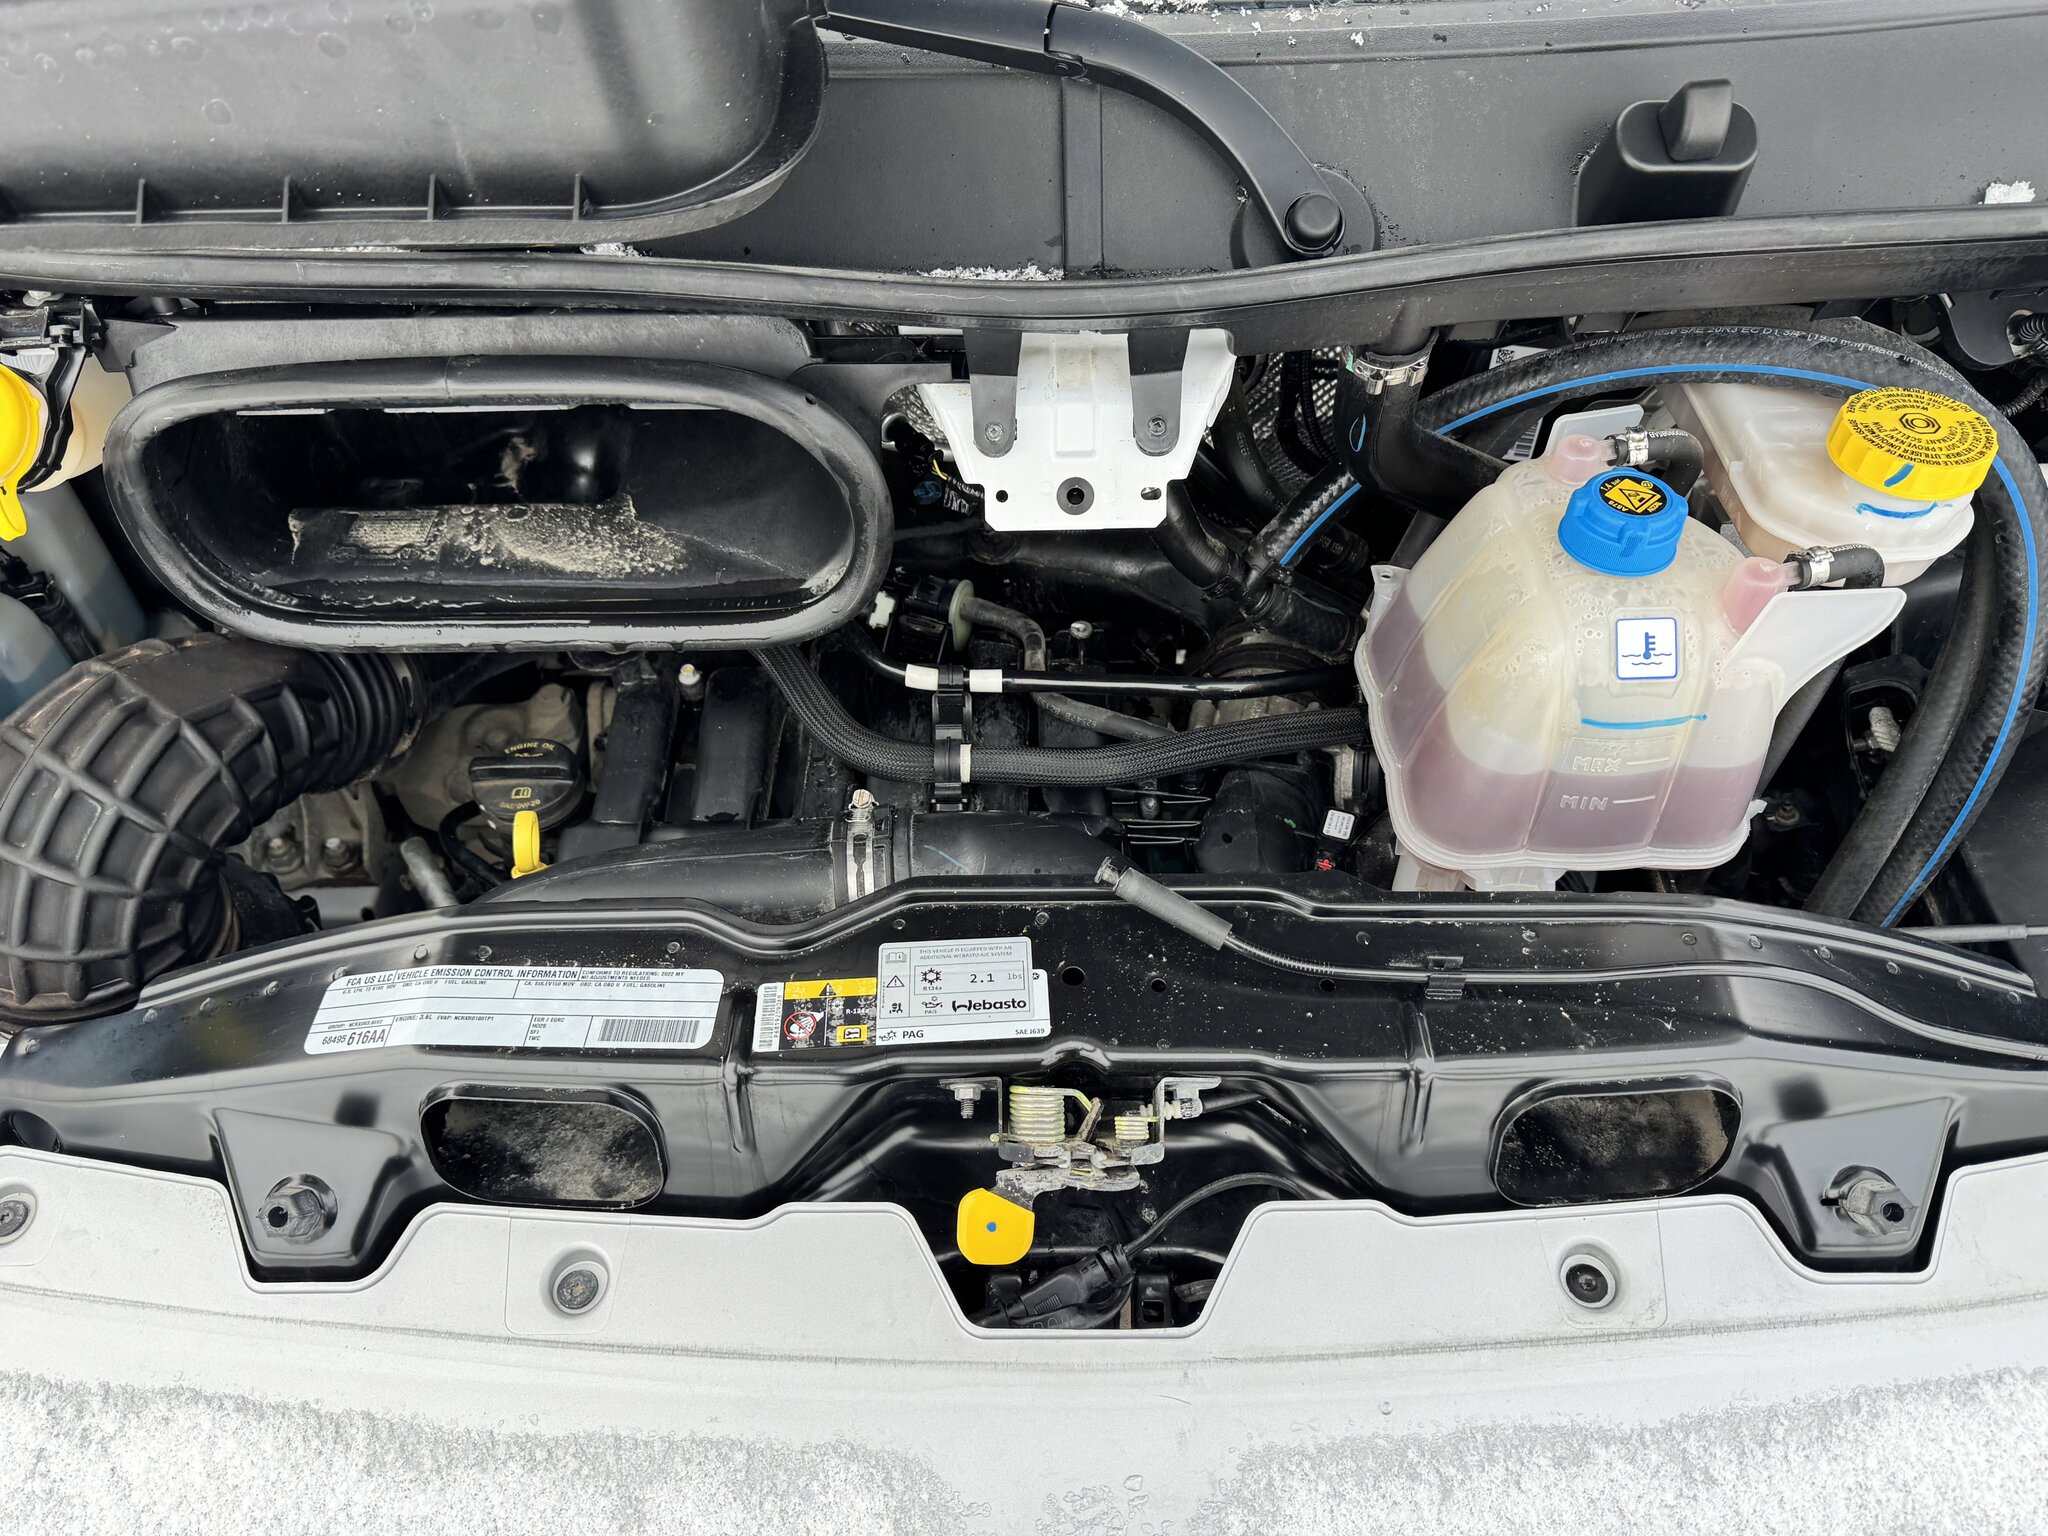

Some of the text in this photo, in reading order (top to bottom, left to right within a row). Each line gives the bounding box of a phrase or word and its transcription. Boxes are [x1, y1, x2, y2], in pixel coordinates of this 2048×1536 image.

[1867, 345, 1900, 358] Made
[1902, 354, 1913, 364] in
[1916, 362, 1954, 382] Mexico
[1954, 402, 1972, 412] DOT
[1859, 422, 1901, 451] UNIQUEMENT
[1882, 433, 1937, 452] PROVENANT
[1896, 453, 1941, 465] BOUCHON
[1901, 447, 1942, 459] UTILISER
[1952, 449, 1988, 465] NETTOYER
[504, 742, 556, 754] ENGINE OIL
[1572, 755, 1622, 772] MAX
[516, 799, 540, 809] 0W-20
[1560, 794, 1608, 810] MIN
[346, 974, 393, 986] FCA US LLC
[397, 968, 578, 980] VEHICLE EMISSION CONTROL INFORMATION
[970, 972, 1022, 983] 2.1 lbs
[952, 998, 1026, 1012] Webasto
[902, 1030, 924, 1039] PAG
